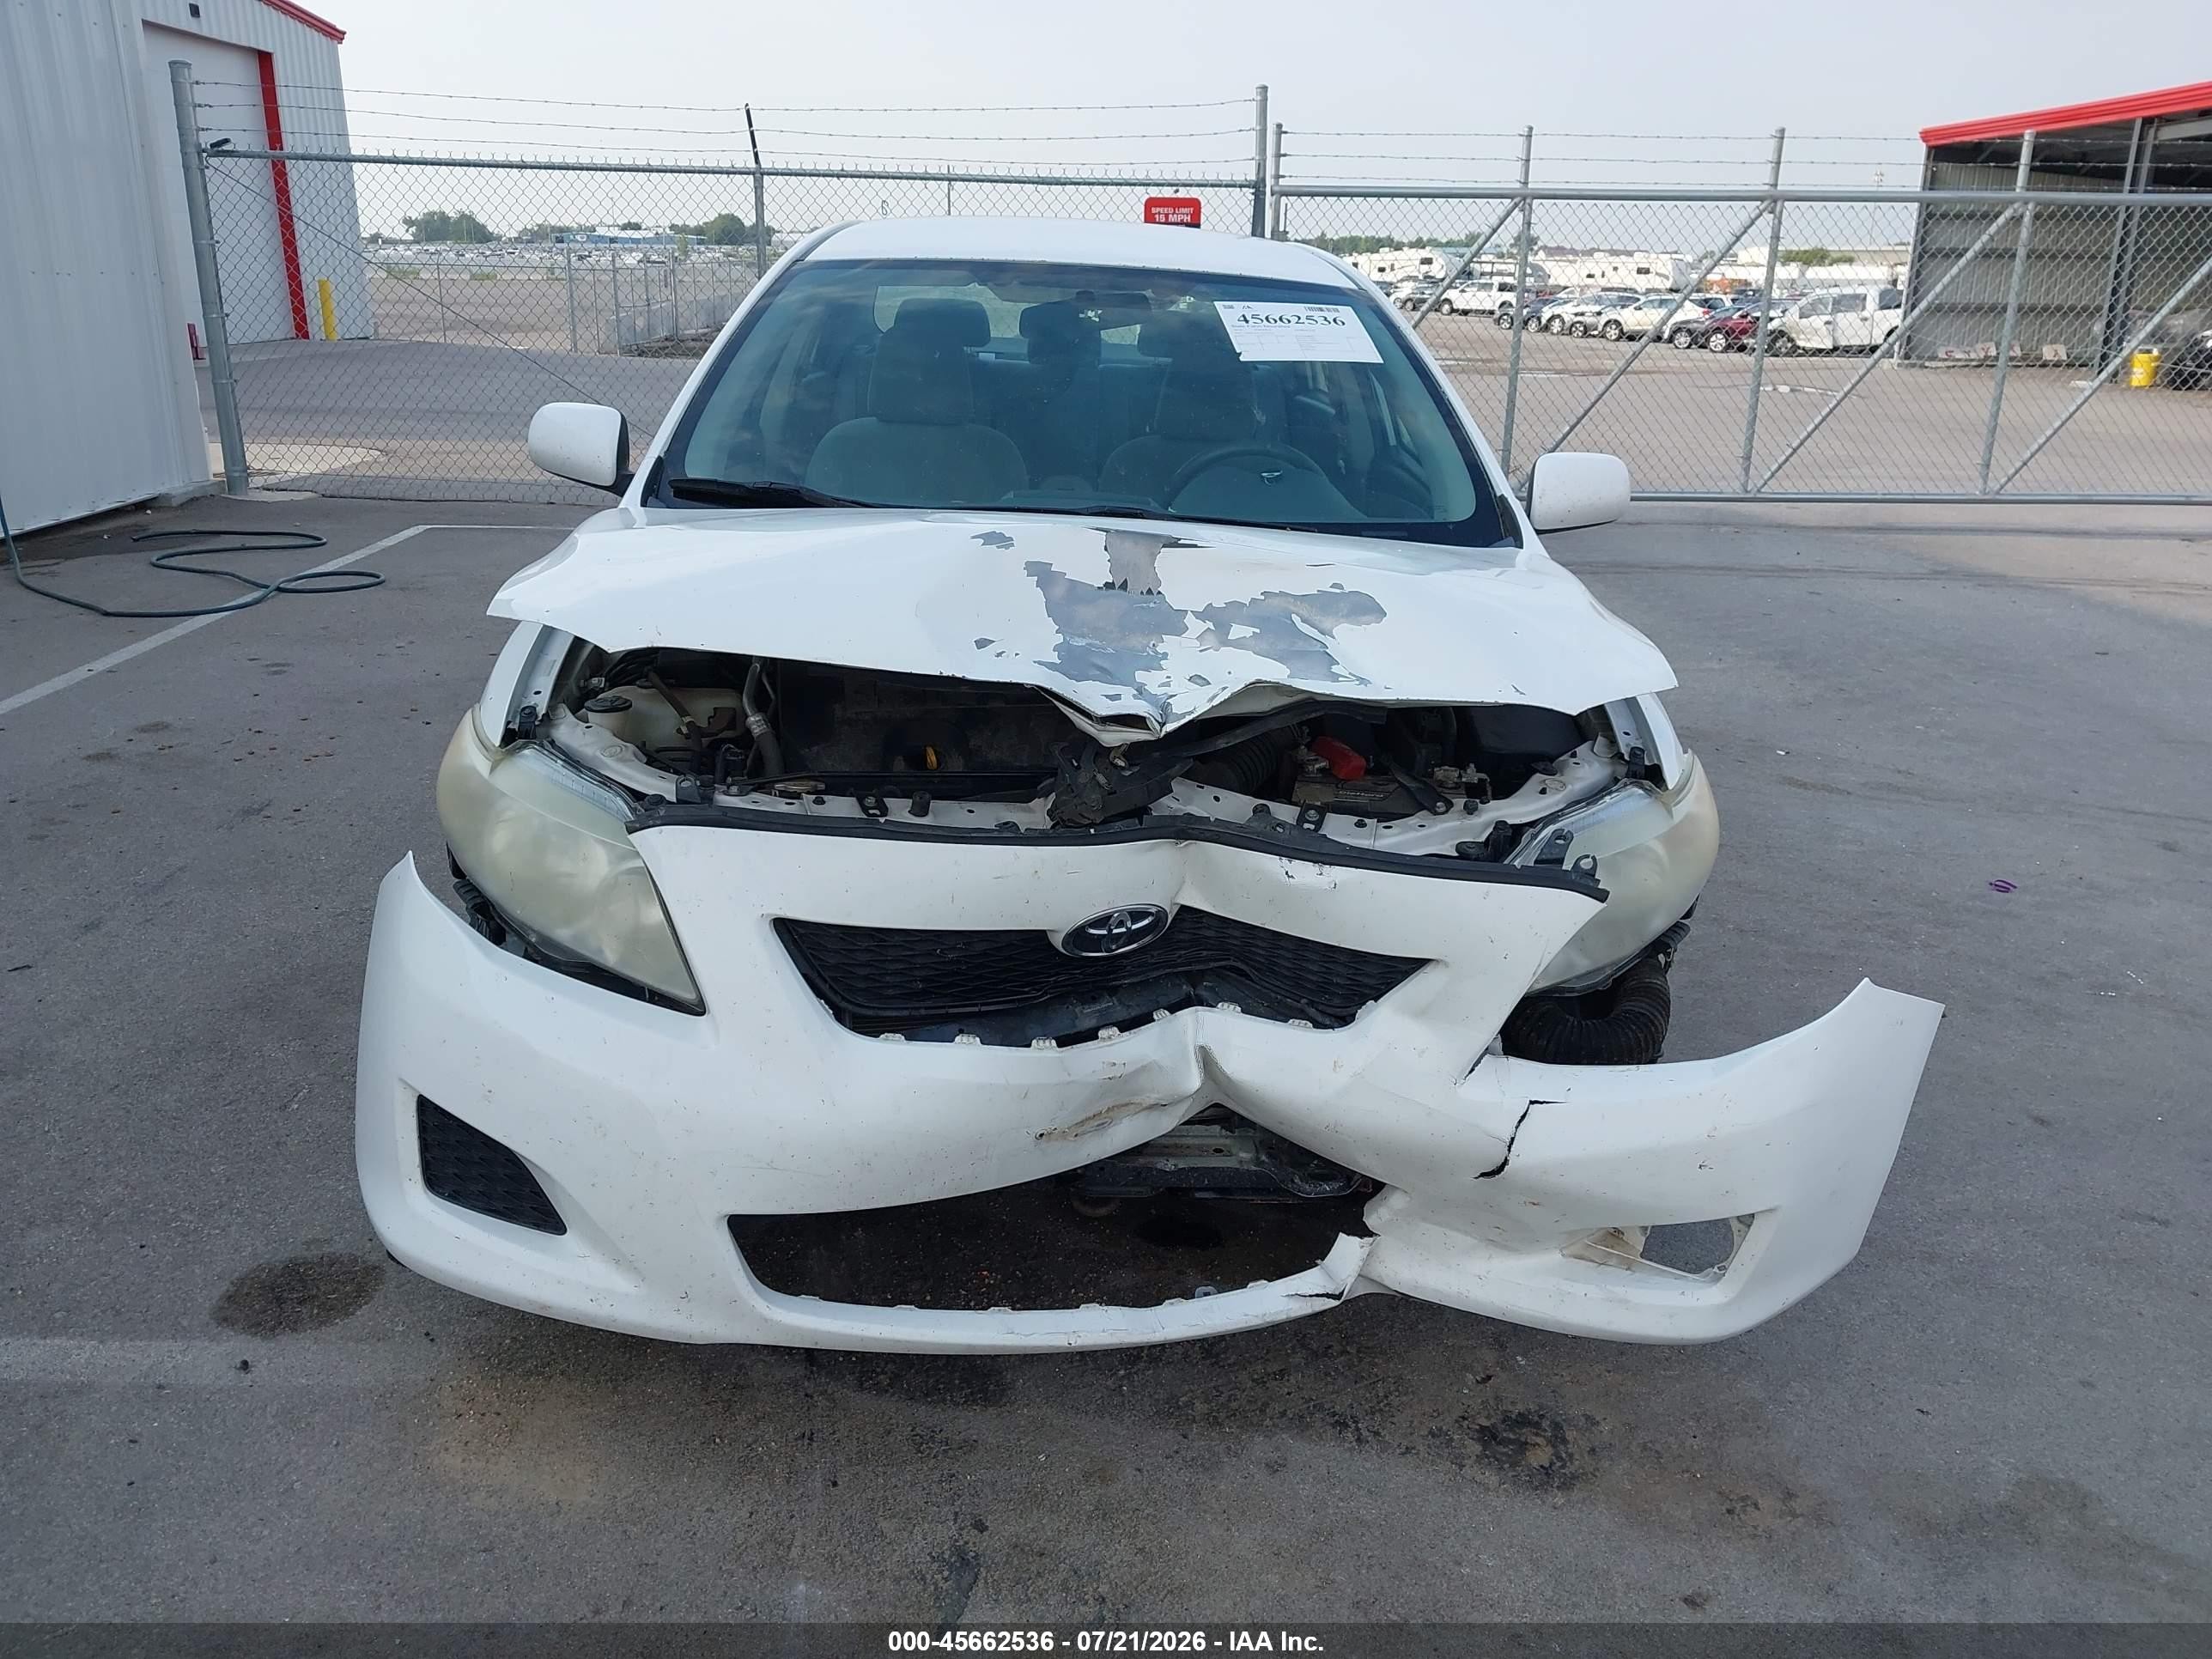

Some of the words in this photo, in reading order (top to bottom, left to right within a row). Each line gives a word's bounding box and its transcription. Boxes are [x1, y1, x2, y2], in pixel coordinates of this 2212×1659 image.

[1154, 214, 1166, 222] 15
[1168, 214, 1192, 223] MPH
[1237, 313, 1346, 327] 45662536
